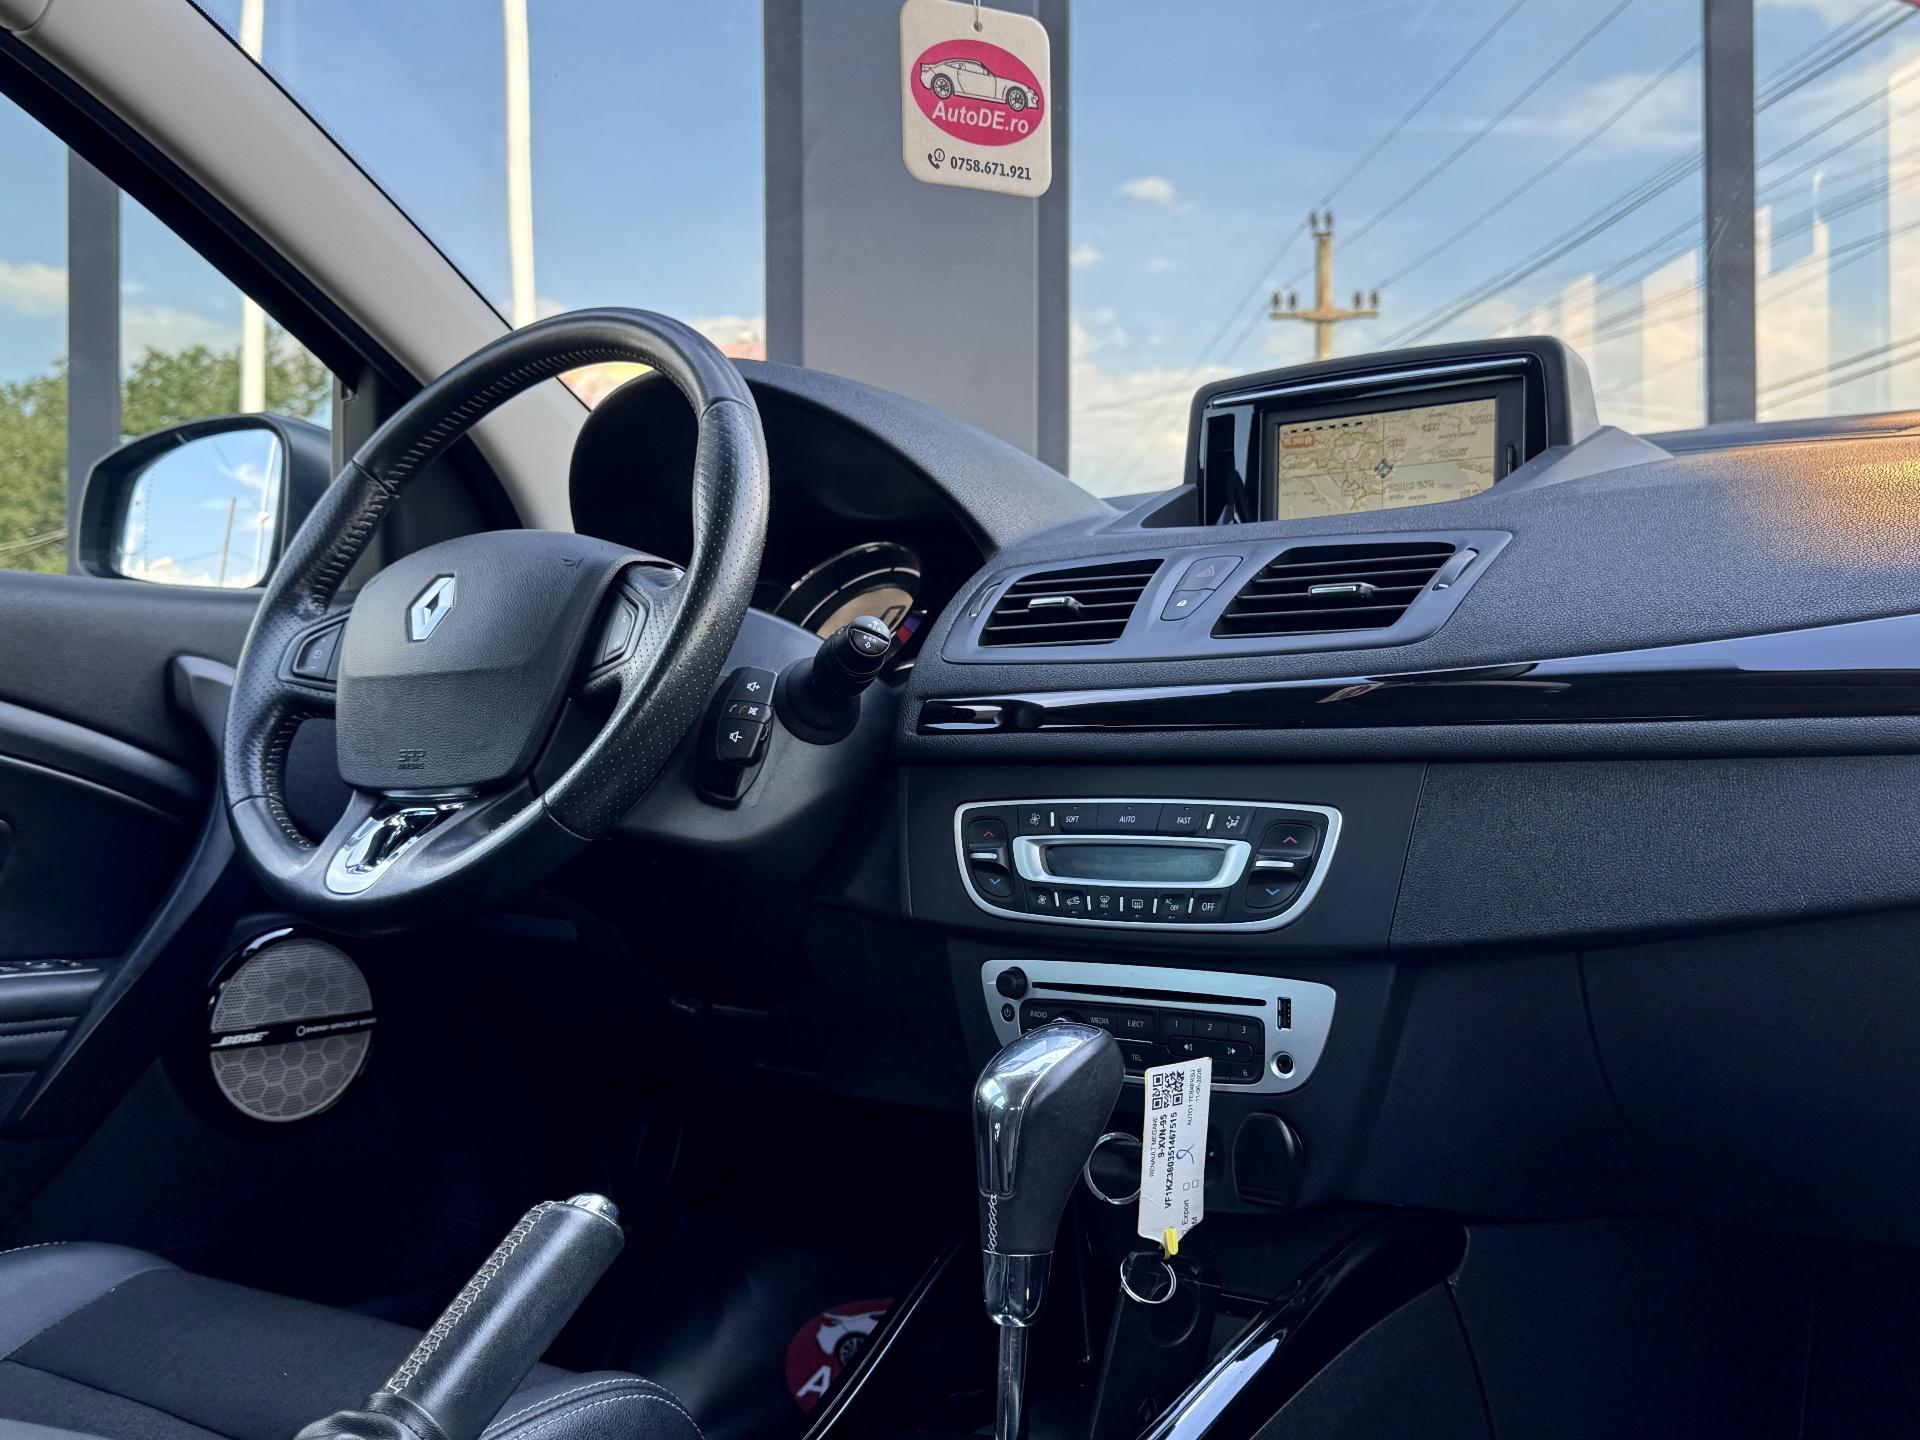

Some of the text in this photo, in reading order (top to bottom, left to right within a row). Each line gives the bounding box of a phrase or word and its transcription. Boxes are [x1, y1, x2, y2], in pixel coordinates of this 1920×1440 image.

[932, 102, 1029, 134] AutoDE.ro
[950, 156, 1031, 181] 0758.671.921
[1065, 815, 1080, 823] SOFT
[1118, 815, 1136, 823] AUTO
[1176, 816, 1191, 824] FAST
[1201, 902, 1216, 912] OFF
[1030, 1010, 1048, 1019] RADIO
[1090, 1016, 1110, 1025] MEDIA
[1127, 1019, 1144, 1028] EJECT
[1207, 1023, 1214, 1031] 2
[1241, 1025, 1247, 1034] 3
[210, 1031, 270, 1048] BOSE
[1131, 1053, 1144, 1062] TEL
[1242, 1069, 1249, 1078] 6
[1157, 1114, 1167, 1158] 9-XVN-95
[1182, 1199, 1190, 1225] Export
